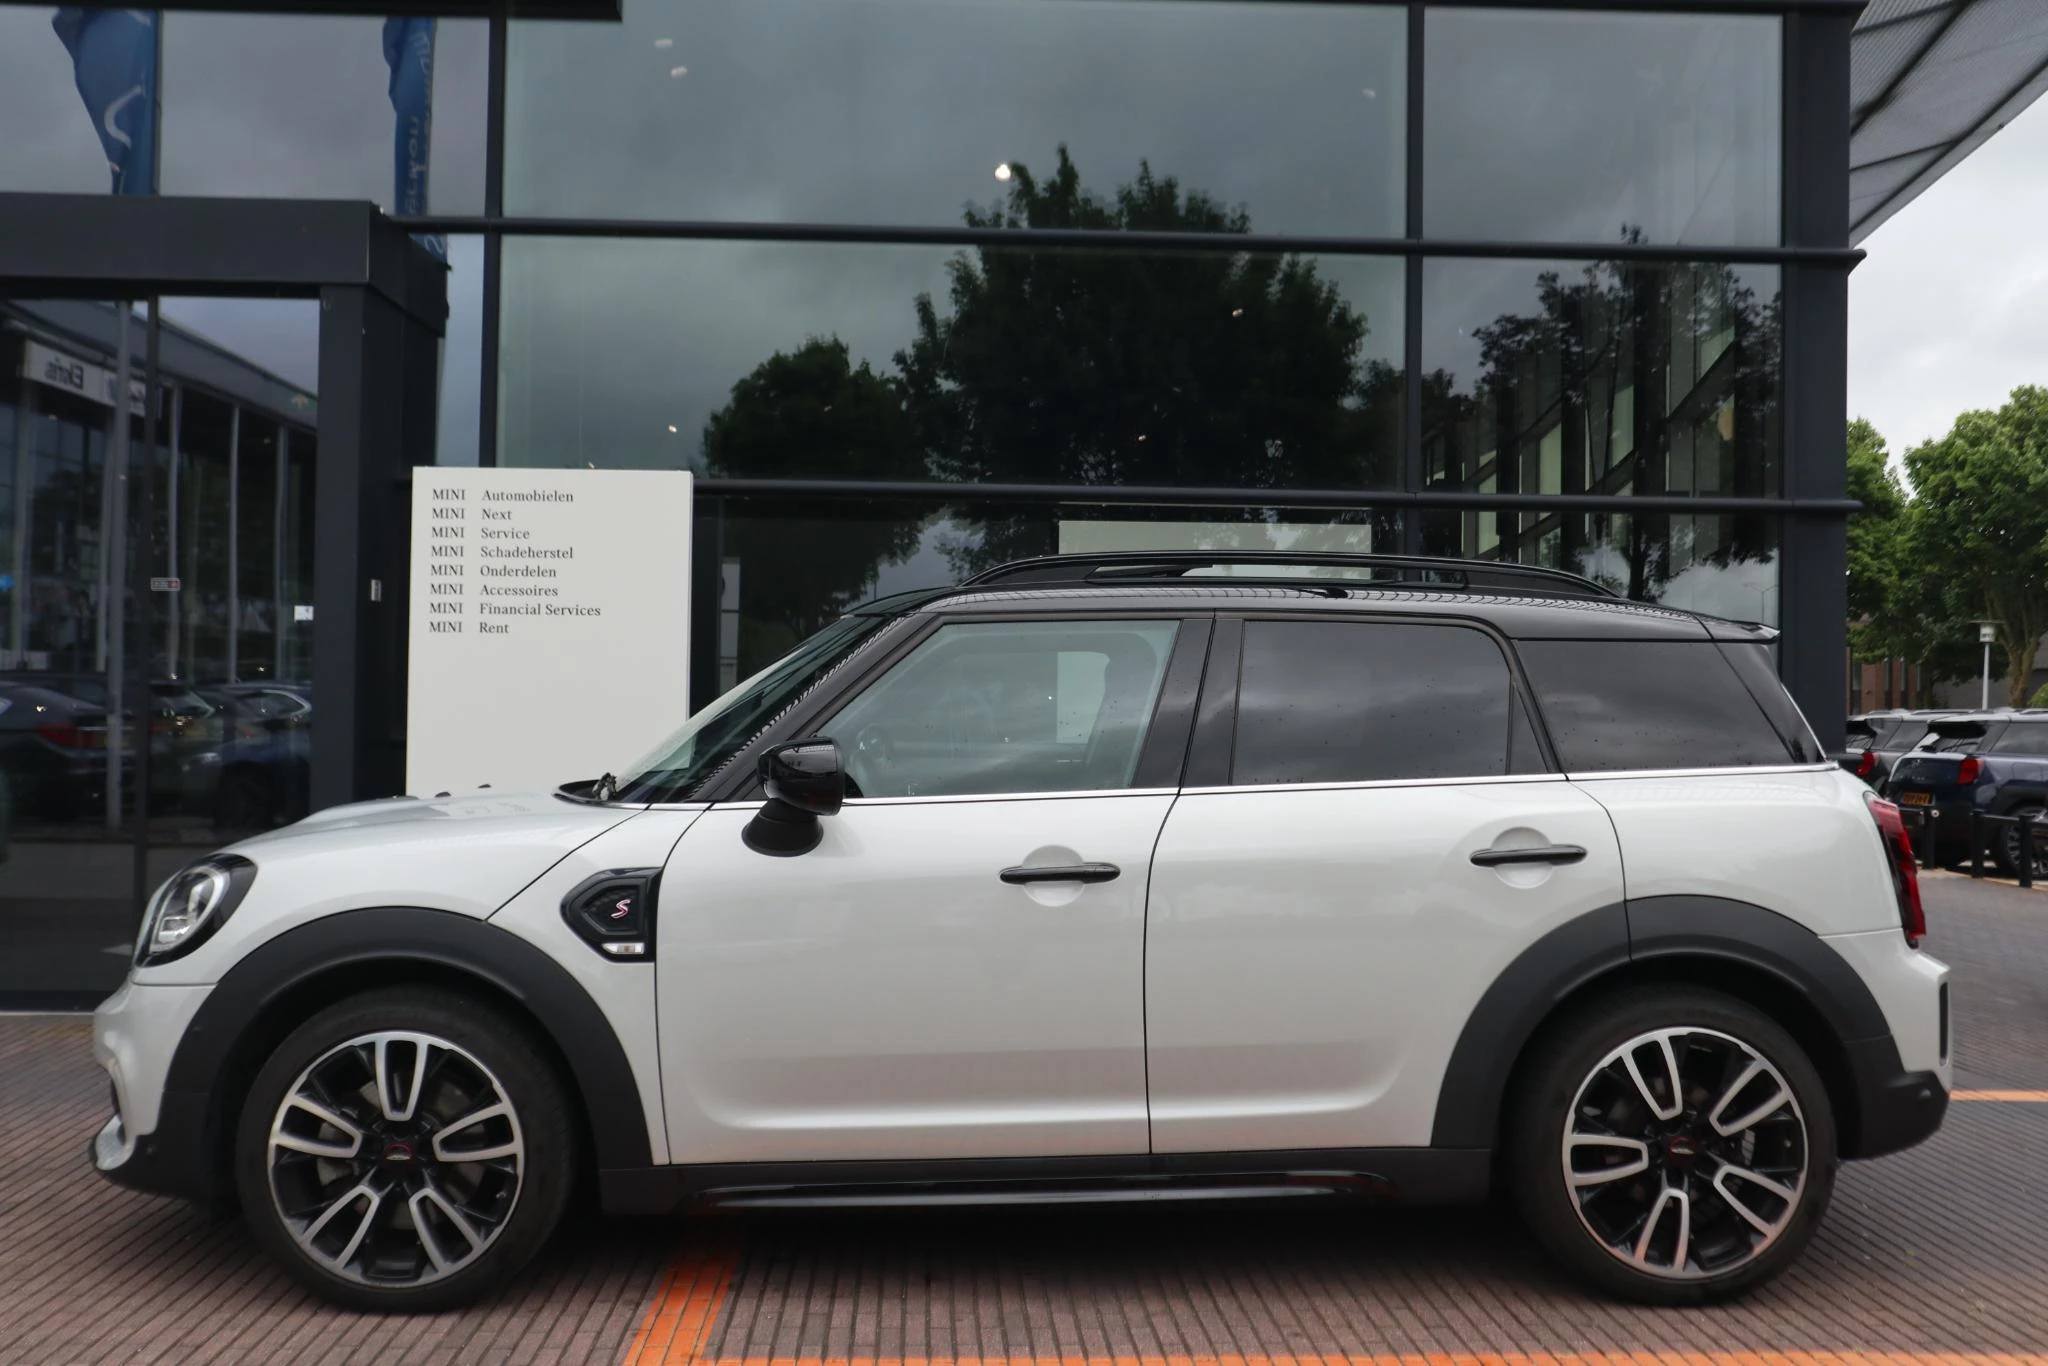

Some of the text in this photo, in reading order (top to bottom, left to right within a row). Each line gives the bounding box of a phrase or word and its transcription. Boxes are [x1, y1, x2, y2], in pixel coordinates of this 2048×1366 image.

[432, 488, 574, 503] MINI Automobielen
[432, 507, 512, 520] MINI Next
[431, 526, 530, 540] MINI Service
[431, 545, 573, 559] MINI Schadeherstel
[431, 564, 557, 578] MINI Onderdelen
[430, 583, 559, 597] MINI Accessoires
[430, 602, 601, 616] MINI Financial Services
[429, 621, 509, 634] MINI Rent
[610, 898, 632, 919] S
